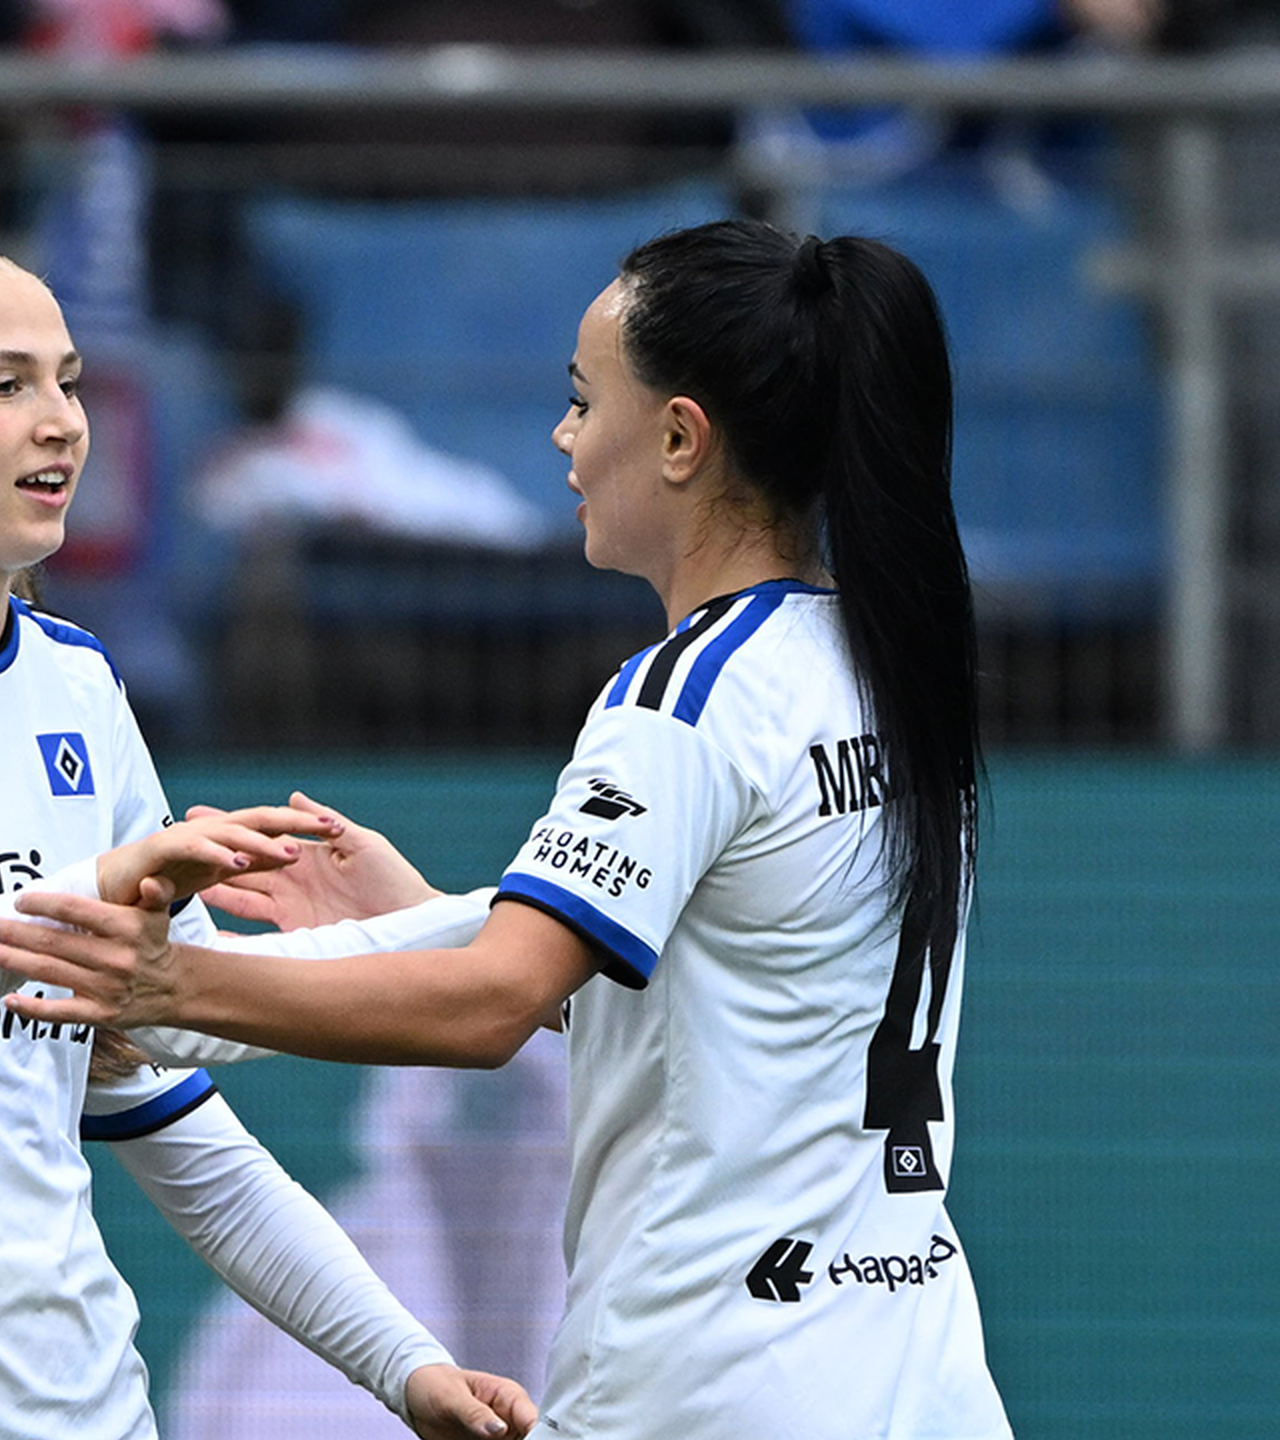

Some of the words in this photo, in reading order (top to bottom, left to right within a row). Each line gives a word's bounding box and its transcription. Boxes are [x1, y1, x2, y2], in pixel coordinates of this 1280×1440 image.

[532, 827, 653, 889] FLOATING
[533, 844, 627, 897] HOMES
[862, 878, 960, 1194] 4
